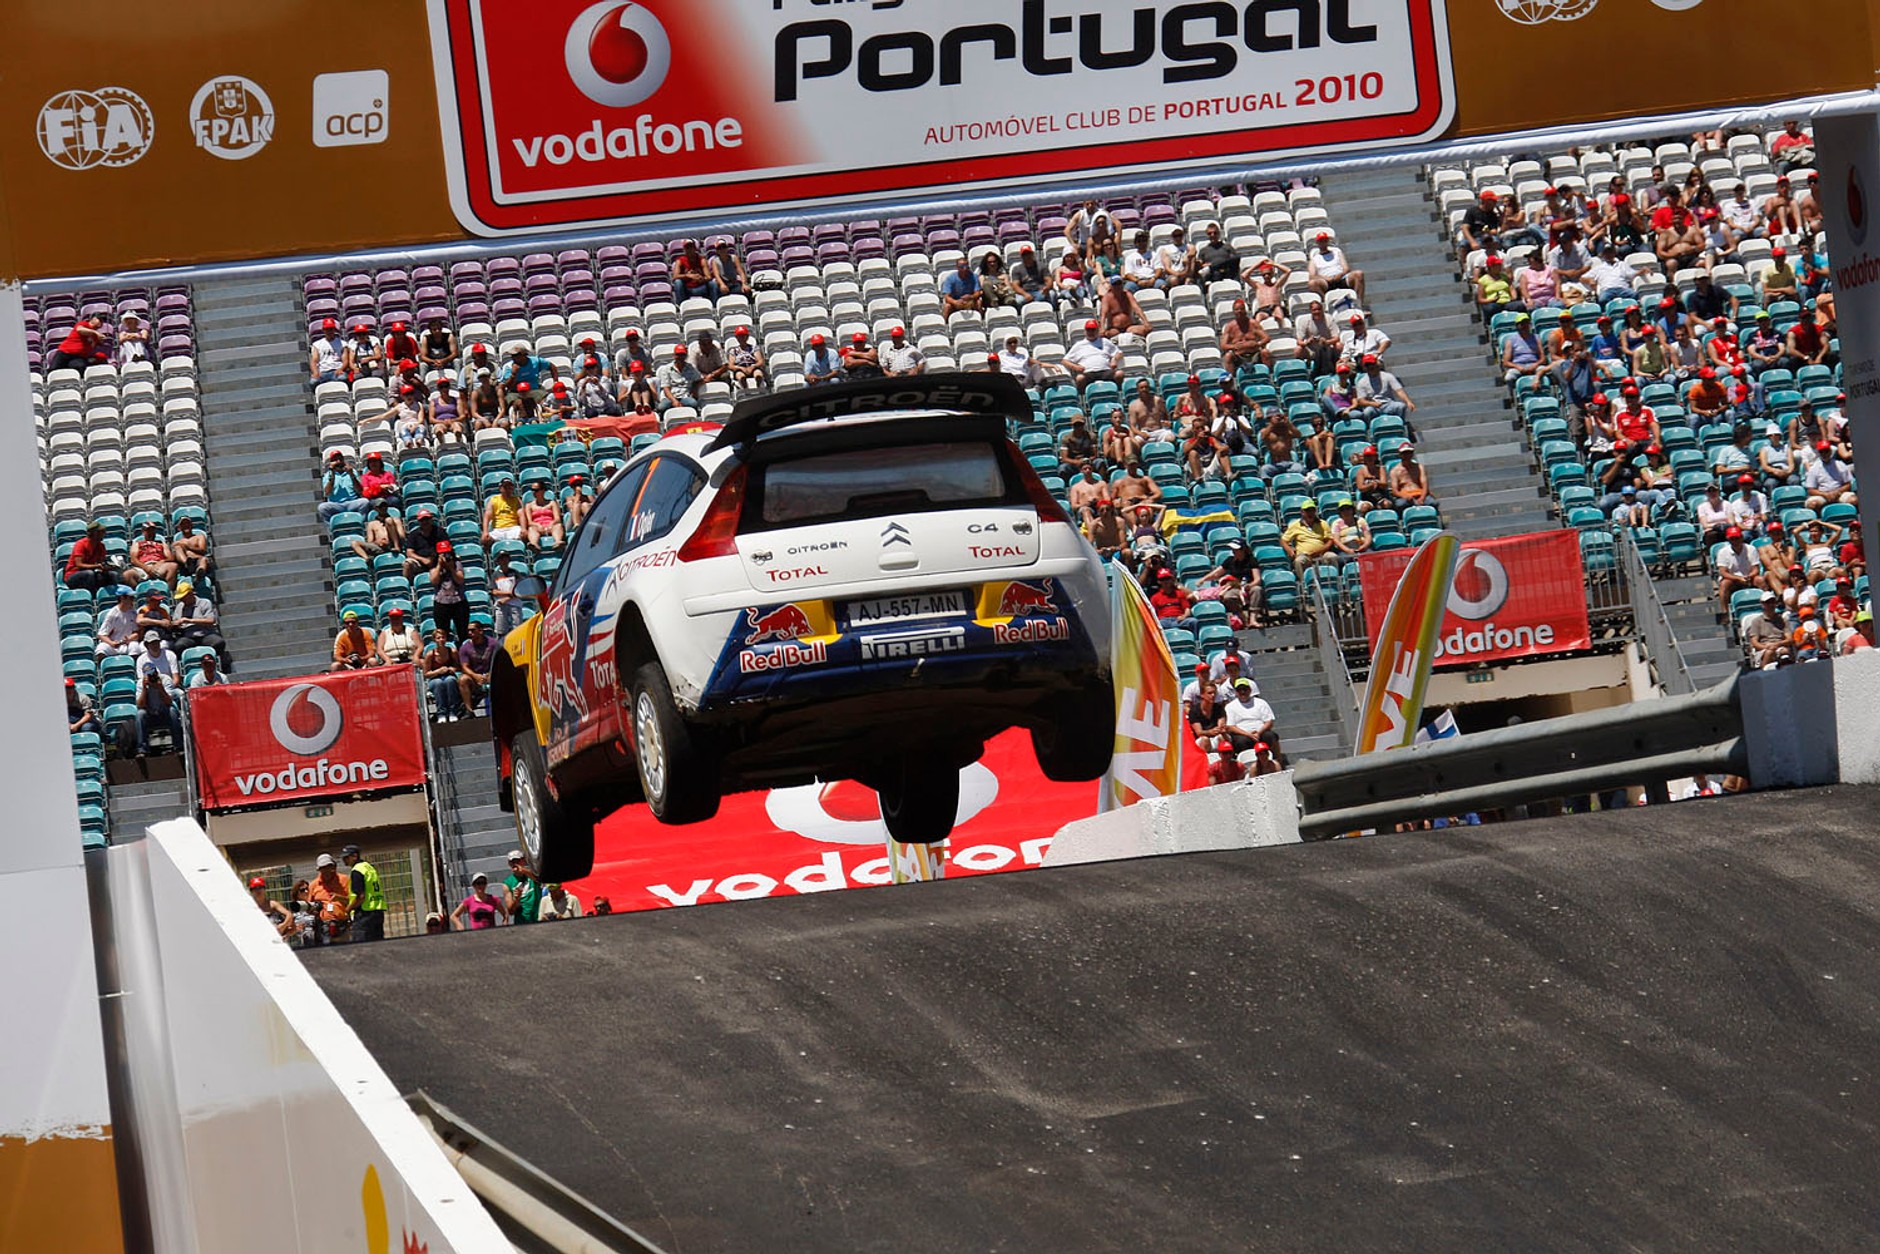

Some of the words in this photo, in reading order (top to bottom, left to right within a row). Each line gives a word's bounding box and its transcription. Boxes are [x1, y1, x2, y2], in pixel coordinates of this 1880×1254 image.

[774, 0, 1378, 102] Portugal
[326, 111, 384, 138] acp
[923, 114, 1061, 146] AUTOMÓVEL
[1065, 108, 1121, 130] CLUB
[1126, 105, 1157, 125] DE
[1163, 92, 1287, 121] PORTUGAL
[1294, 71, 1385, 107] 2010
[194, 113, 273, 147] FPAK
[511, 114, 743, 168] vodafone
[1836, 252, 1880, 291] vodafon
[759, 386, 994, 428] CITROËN
[967, 523, 999, 534] C4
[859, 594, 959, 622] AJ-557-MN
[860, 626, 965, 659] PIRELLI
[992, 619, 1035, 644] Red
[1034, 616, 1070, 641] Bull
[740, 645, 783, 673] Red
[783, 640, 827, 667] Bull
[590, 660, 617, 689] TOTA
[234, 758, 389, 796] vodafone
